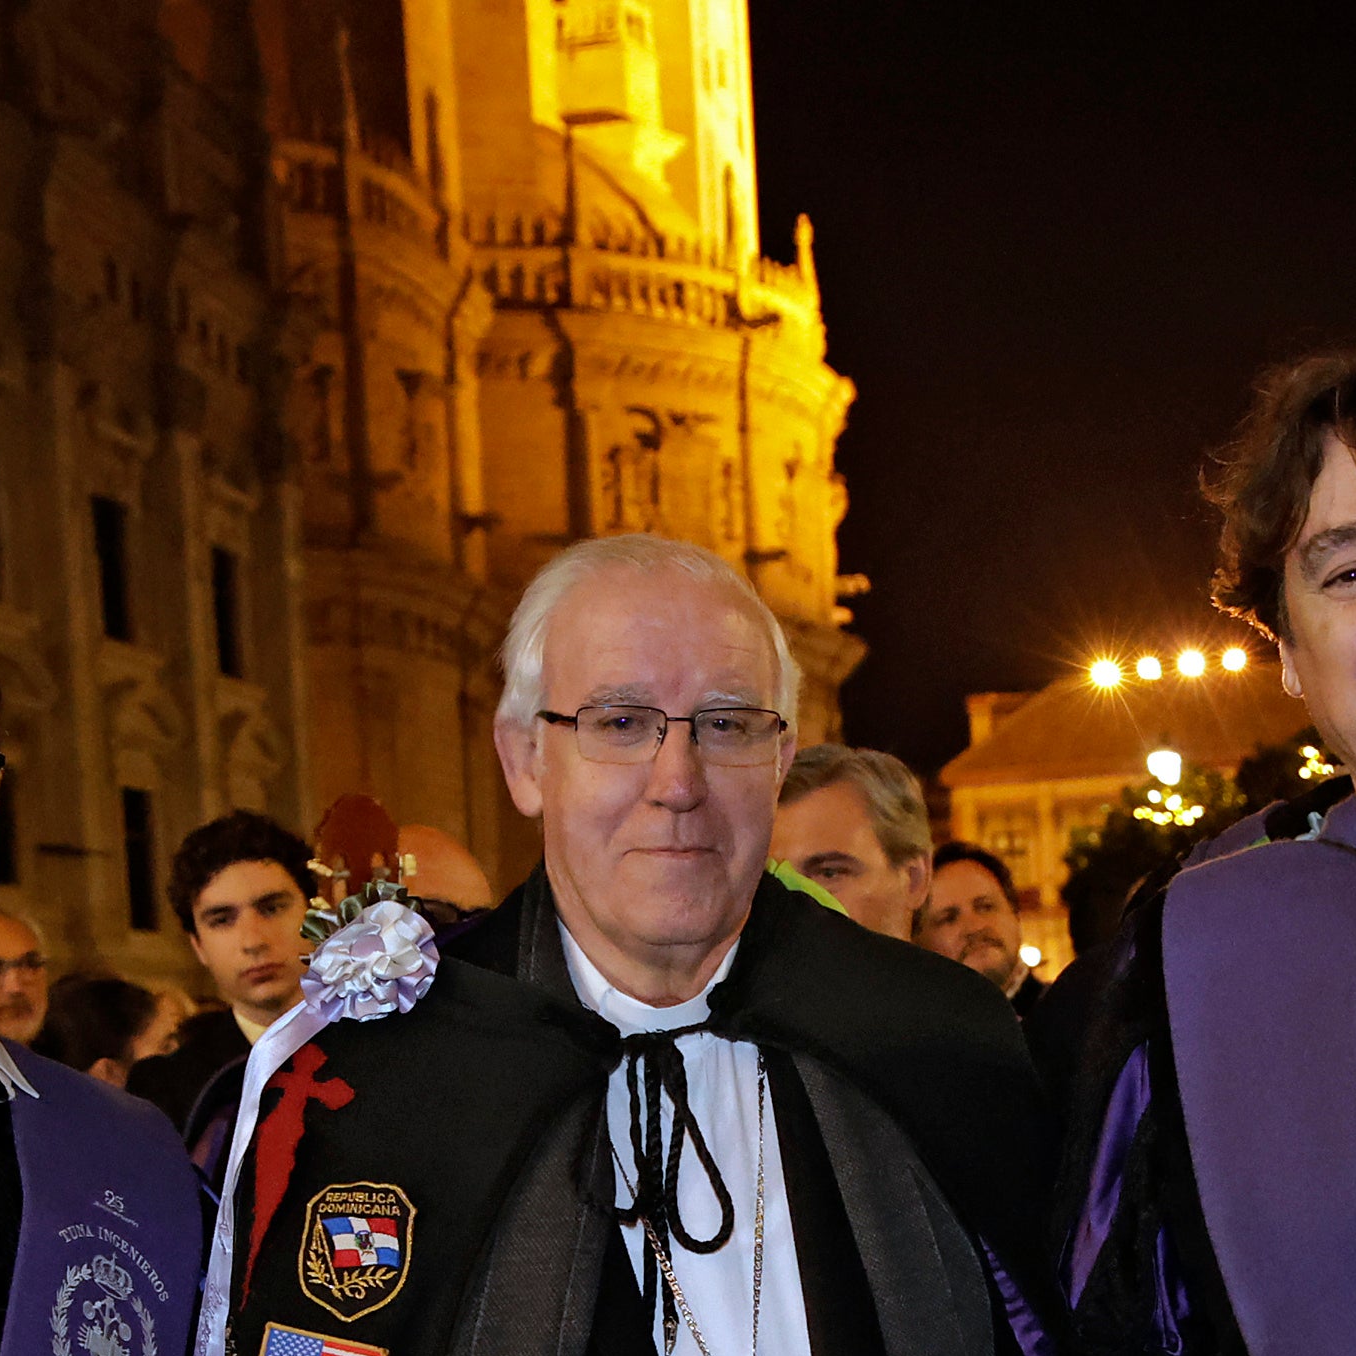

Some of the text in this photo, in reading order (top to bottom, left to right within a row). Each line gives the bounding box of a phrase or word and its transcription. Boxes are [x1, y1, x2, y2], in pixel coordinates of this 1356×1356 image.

[325, 1191, 397, 1205] REPUBLICA
[317, 1202, 402, 1217] DOMINICANA
[58, 1222, 169, 1303] TUNA INGENIEROS
